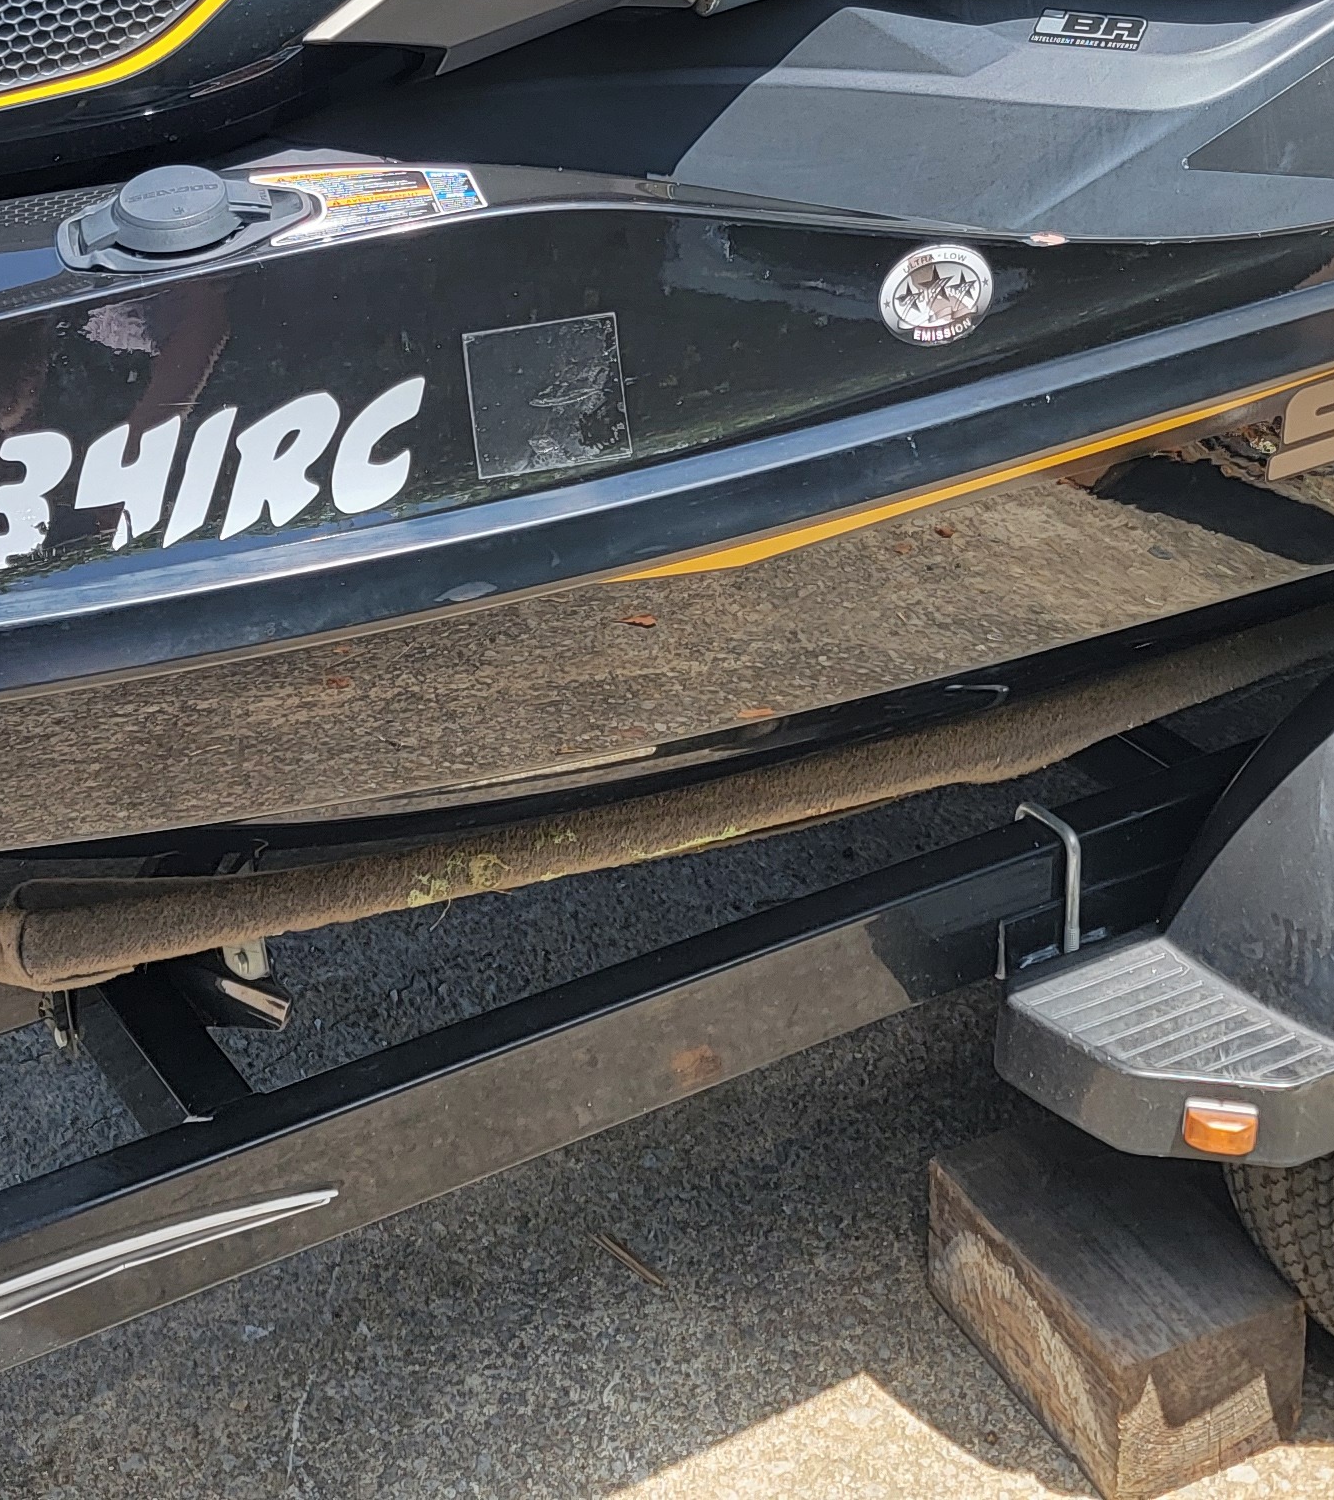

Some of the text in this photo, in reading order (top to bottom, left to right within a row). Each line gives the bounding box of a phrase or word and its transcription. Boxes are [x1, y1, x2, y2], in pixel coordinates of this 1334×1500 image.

[1030, 35, 1075, 45] INTELLIGENT
[1075, 39, 1100, 47] BRAKE
[1107, 42, 1138, 50] REVERSE
[913, 317, 972, 342] EMISSION
